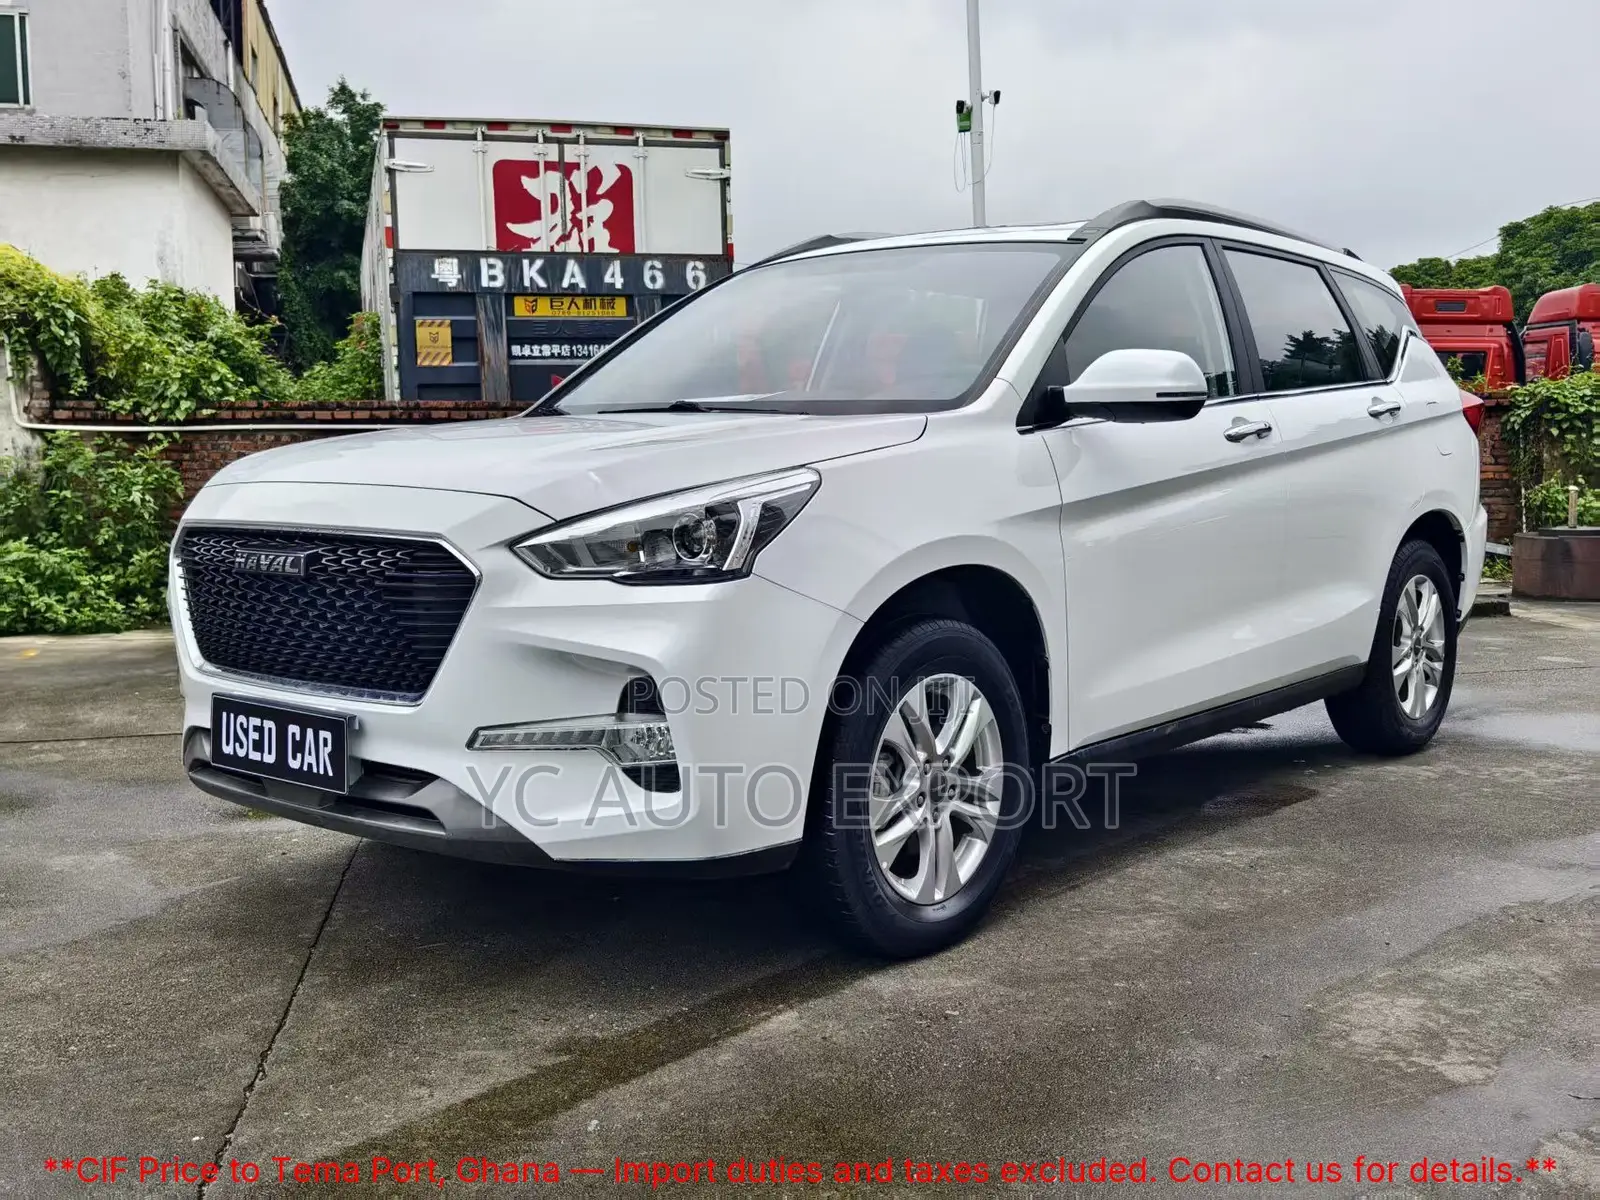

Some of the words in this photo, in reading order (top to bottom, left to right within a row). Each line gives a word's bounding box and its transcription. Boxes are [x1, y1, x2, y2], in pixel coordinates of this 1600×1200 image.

[550, 298, 616, 310] 巨人机械
[235, 552, 299, 573] HAVAL
[221, 711, 277, 765] USED
[287, 723, 334, 777] CAR
